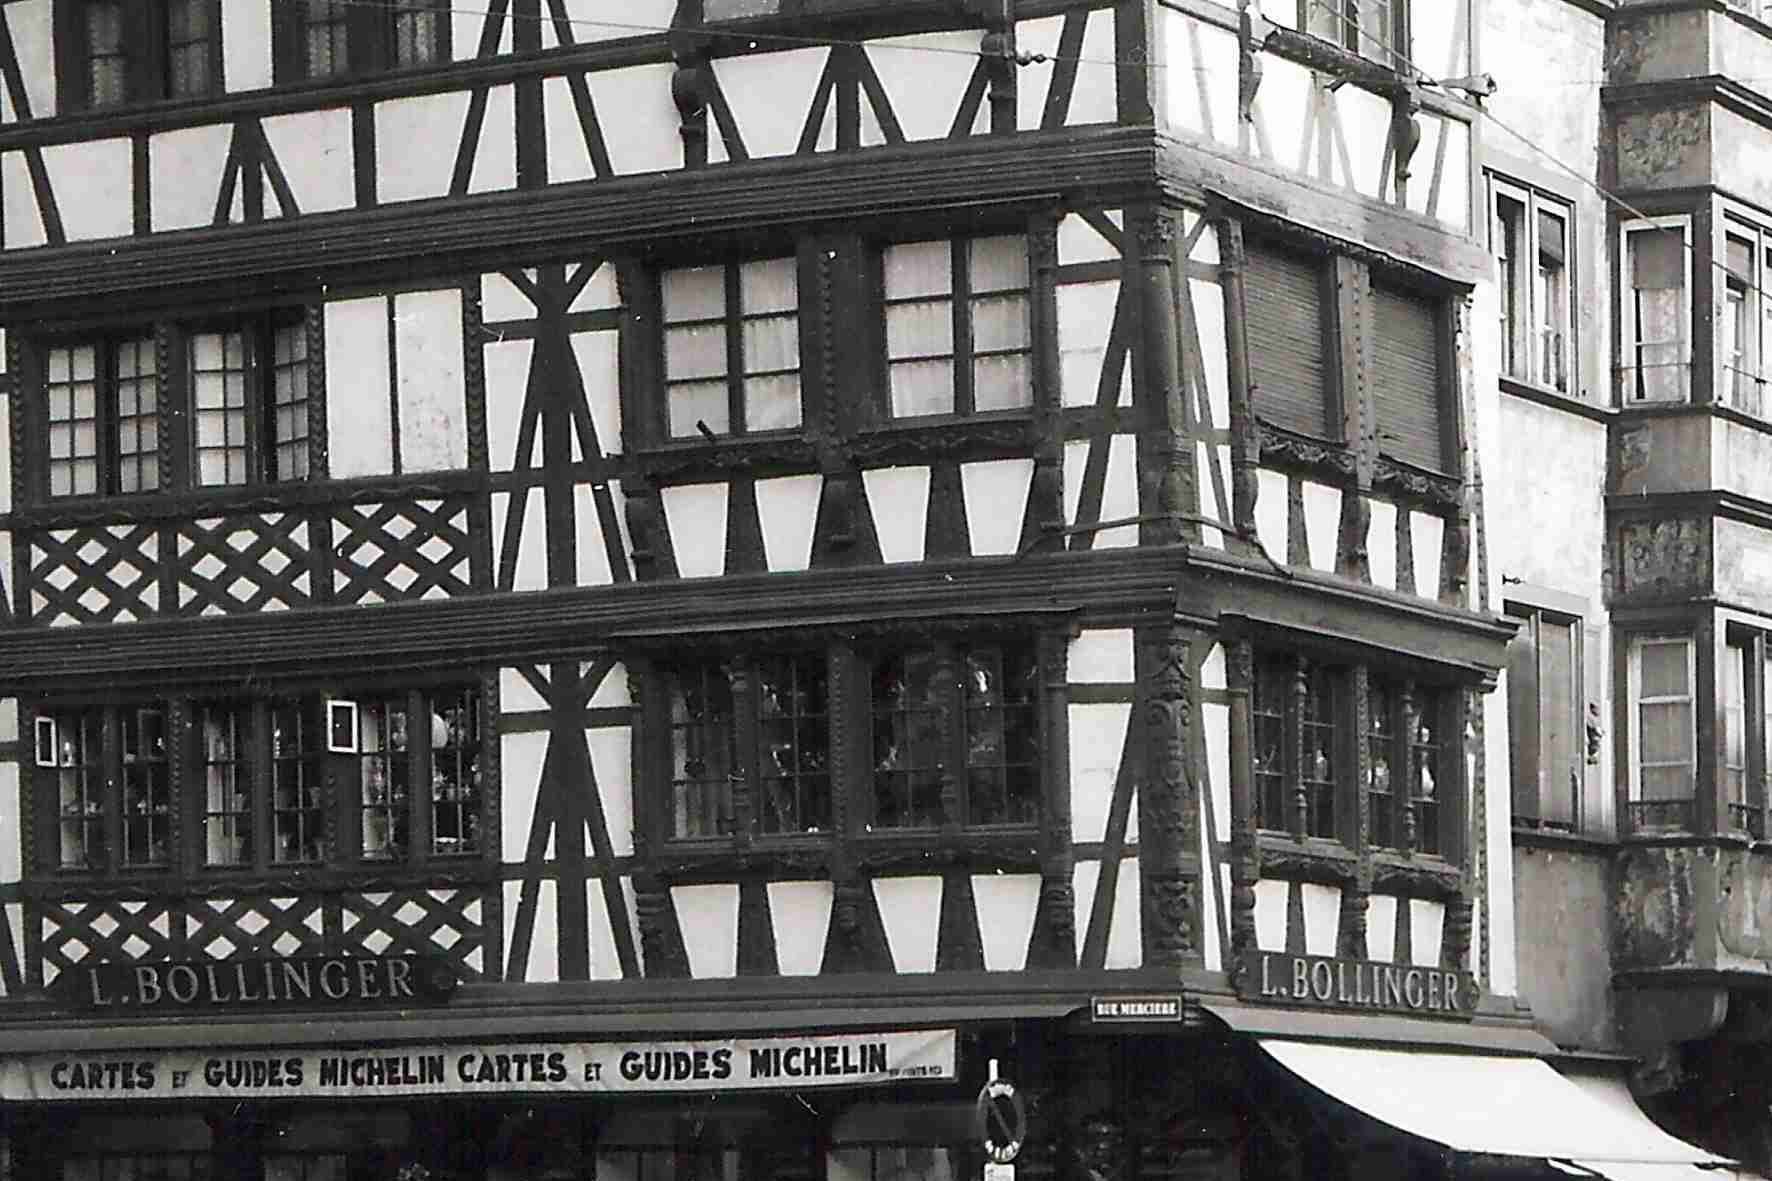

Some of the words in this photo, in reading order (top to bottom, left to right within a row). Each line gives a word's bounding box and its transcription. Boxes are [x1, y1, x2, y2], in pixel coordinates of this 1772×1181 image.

[50, 1061, 155, 1090] CARTES
[171, 1070, 191, 1089] ET
[204, 1057, 304, 1088] GUIDES
[319, 1054, 446, 1086] MICHELIN
[457, 1052, 568, 1084] CARTES
[584, 1061, 602, 1083] ET
[619, 1048, 733, 1082] GUIDES
[749, 1043, 888, 1080] MICHELIN
